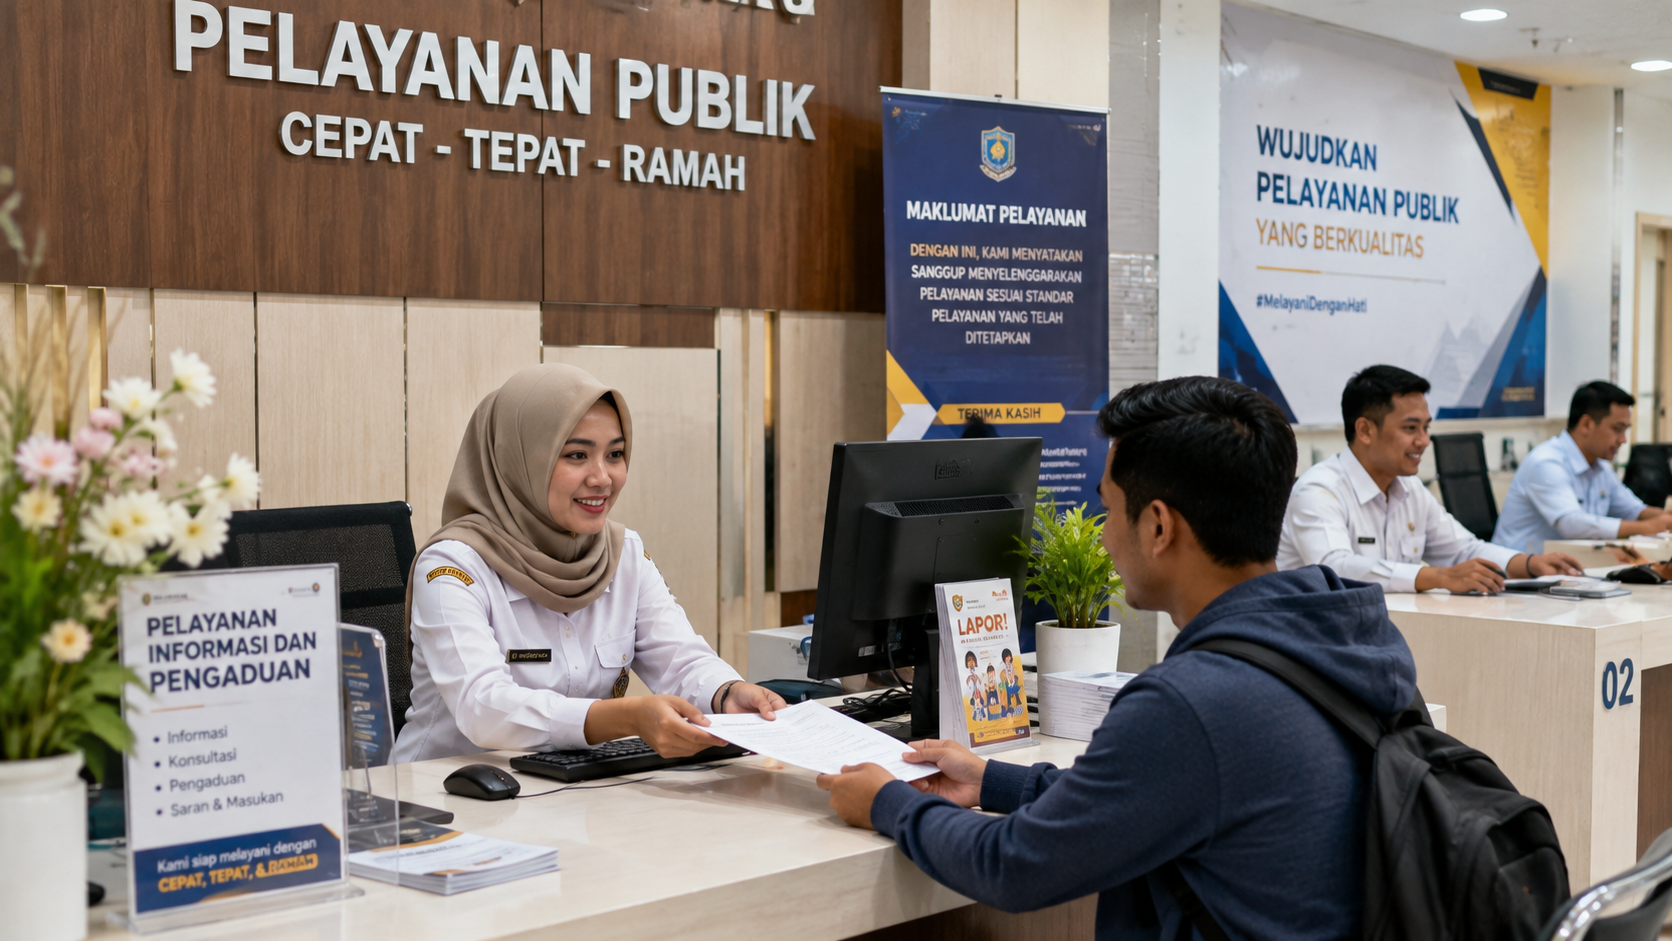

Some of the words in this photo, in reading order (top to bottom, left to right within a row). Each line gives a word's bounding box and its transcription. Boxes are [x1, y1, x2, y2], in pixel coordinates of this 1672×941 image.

[174, 0, 592, 115] PELAYANAN
[615, 57, 816, 140] PUBLIK
[279, 110, 424, 164] CEPAT
[463, 127, 586, 177] TEPAT
[621, 143, 746, 191] RAMAH
[1257, 124, 1377, 172] WUJUDKAN
[1257, 171, 1387, 216] PELAYANAN
[1393, 190, 1459, 224] PUBLIK
[906, 200, 996, 223] MAKLUMAT
[999, 205, 1086, 227] PELAYANAN
[1256, 218, 1308, 248] YANG
[1313, 225, 1424, 258] BERKUALITAS
[910, 243, 959, 258] DENGAN
[961, 246, 980, 261] INI,
[982, 246, 1009, 259] KAMI
[1012, 247, 1083, 262] MENYATAKAN
[911, 265, 966, 280] SANGGUP
[968, 267, 1082, 283] MENYELENGGARAKAN
[920, 287, 984, 301] PELAYANAN
[986, 289, 1023, 302] SESUAI
[1026, 290, 1074, 303] STANDAR
[932, 309, 996, 323] PELAYANAN
[998, 310, 1028, 323] YANG
[1031, 311, 1063, 324] TELAH
[966, 331, 1030, 344] DITETAPKAN
[958, 408, 1002, 419] TERIMA
[1006, 407, 1041, 419] KASIH
[147, 608, 277, 637] PELAYANAN
[958, 612, 1008, 635] LAPOR!
[148, 636, 268, 663] INFORMASI
[274, 632, 317, 652] DAN
[150, 658, 311, 694] PENGADUAN
[1602, 658, 1634, 710] 02
[167, 725, 228, 744] Informasi
[168, 748, 237, 768] Konsultasi
[170, 773, 245, 793] Pengaduan
[171, 801, 209, 817] Saran
[213, 799, 223, 810] &
[227, 791, 284, 809] Masukan
[157, 856, 189, 873] Kami
[192, 853, 217, 870] siap
[219, 844, 271, 865] melayani
[273, 837, 317, 858] dengan
[158, 872, 206, 893] CEPAT,
[209, 865, 253, 884] TEPAT,
